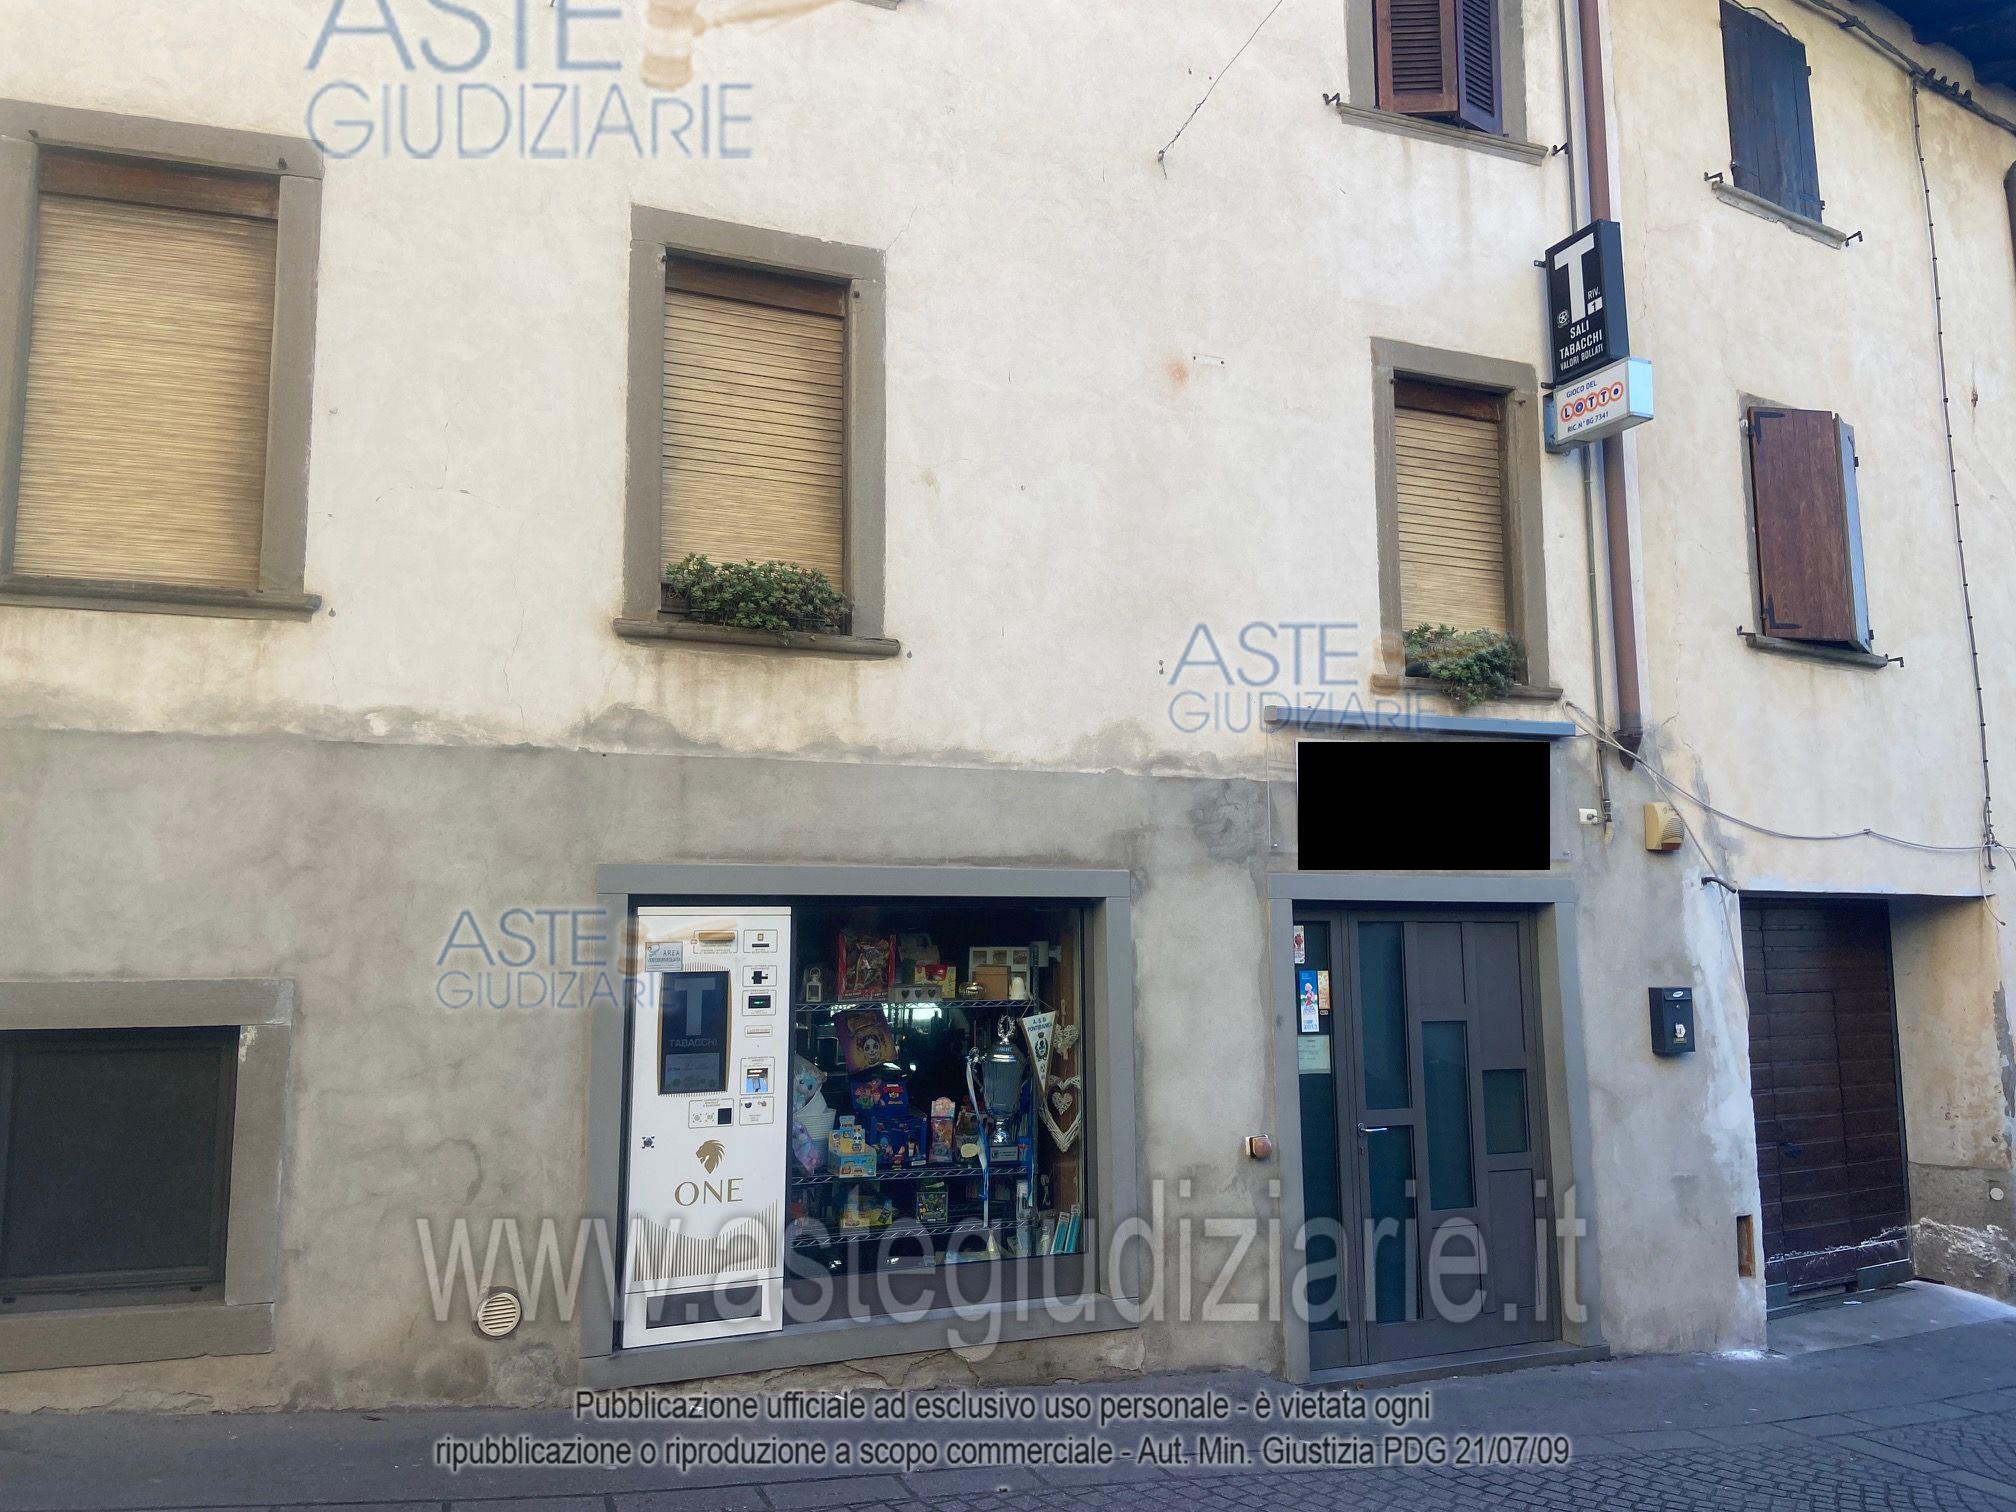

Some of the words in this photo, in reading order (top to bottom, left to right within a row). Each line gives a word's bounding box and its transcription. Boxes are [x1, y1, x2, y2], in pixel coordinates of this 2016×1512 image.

[1554, 233, 1595, 324] T
[1569, 319, 1590, 339] SALI
[1559, 329, 1603, 360] TABACCHI
[1560, 355, 1580, 371] VALORI
[1580, 343, 1604, 362] BOLLATI
[1563, 385, 1621, 419] LOTTO
[1566, 385, 1585, 398] GIOCO
[1585, 380, 1597, 390] DEL
[670, 1037, 719, 1048] TABACCHI
[674, 1178, 744, 1207] ONE
